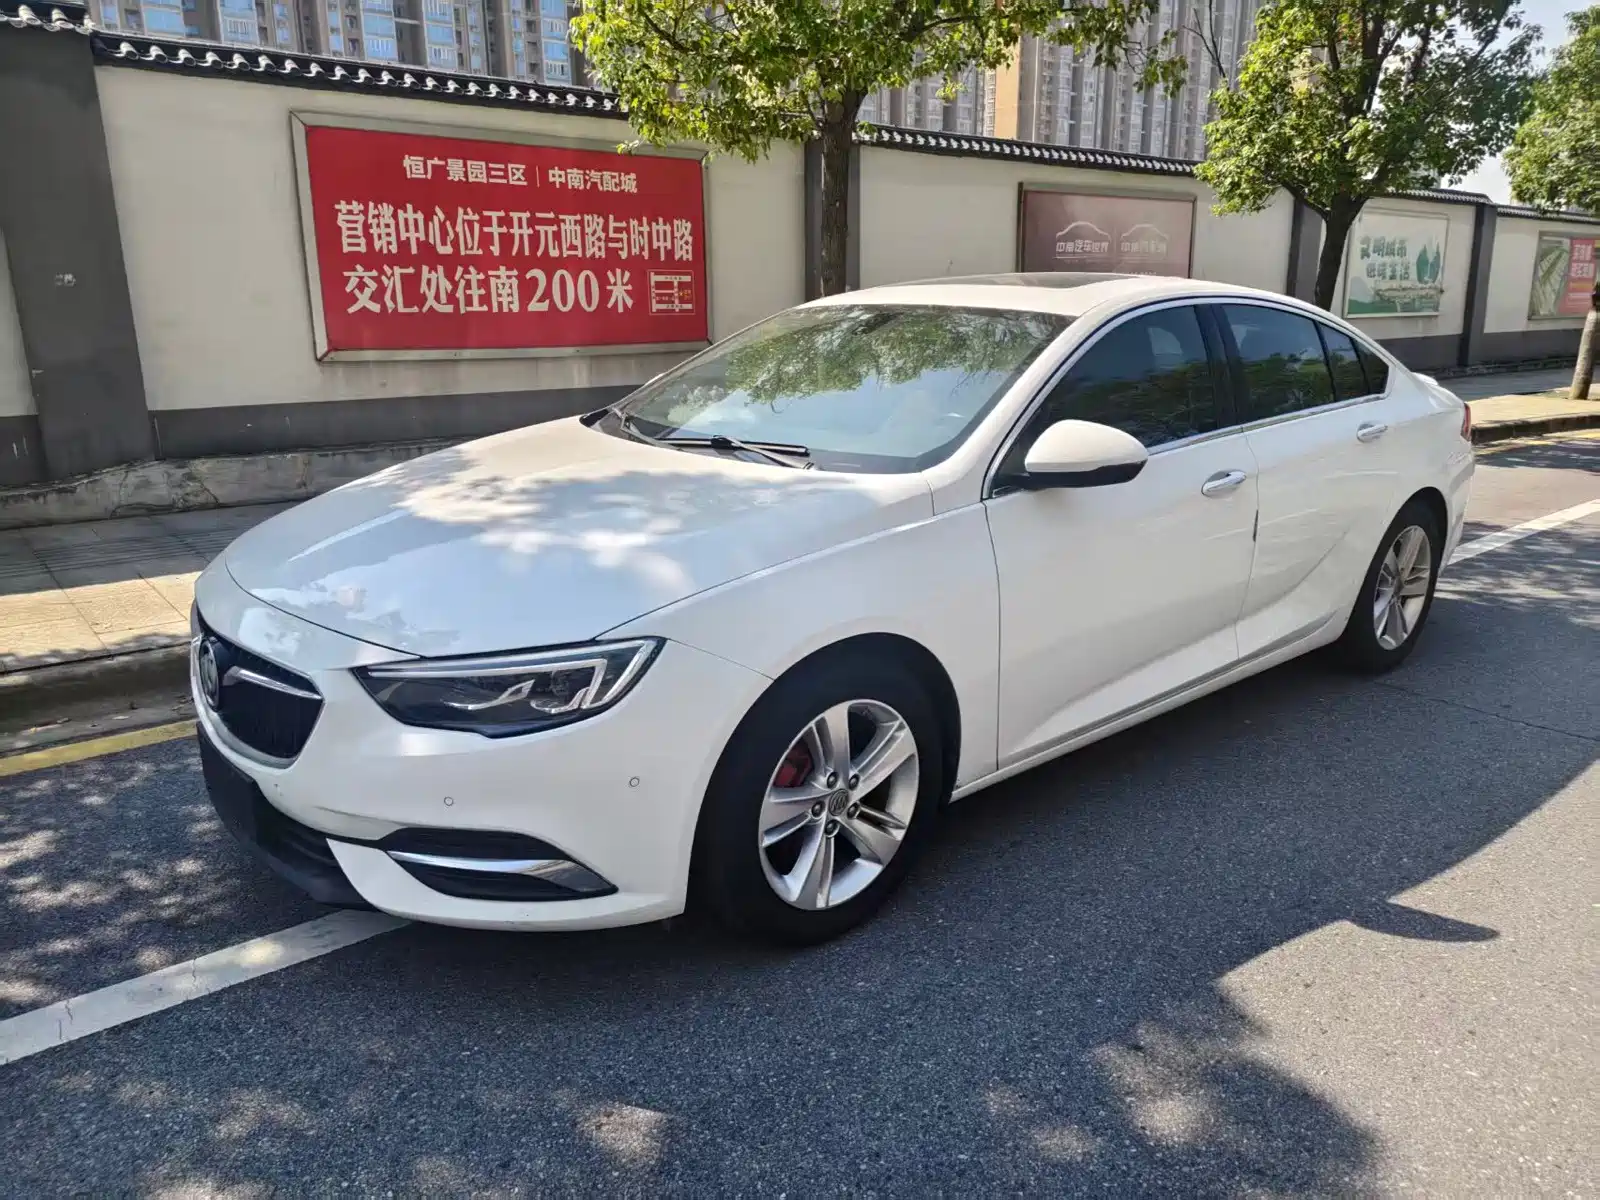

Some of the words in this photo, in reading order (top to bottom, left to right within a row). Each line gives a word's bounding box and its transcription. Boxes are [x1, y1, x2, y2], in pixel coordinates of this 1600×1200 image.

[403, 154, 528, 186] 恒广景园三区
[548, 166, 638, 193] 中南汽配城
[334, 199, 694, 262] 营销中心位于开元西路与时中路
[342, 264, 634, 315] 交汇处往南200米
